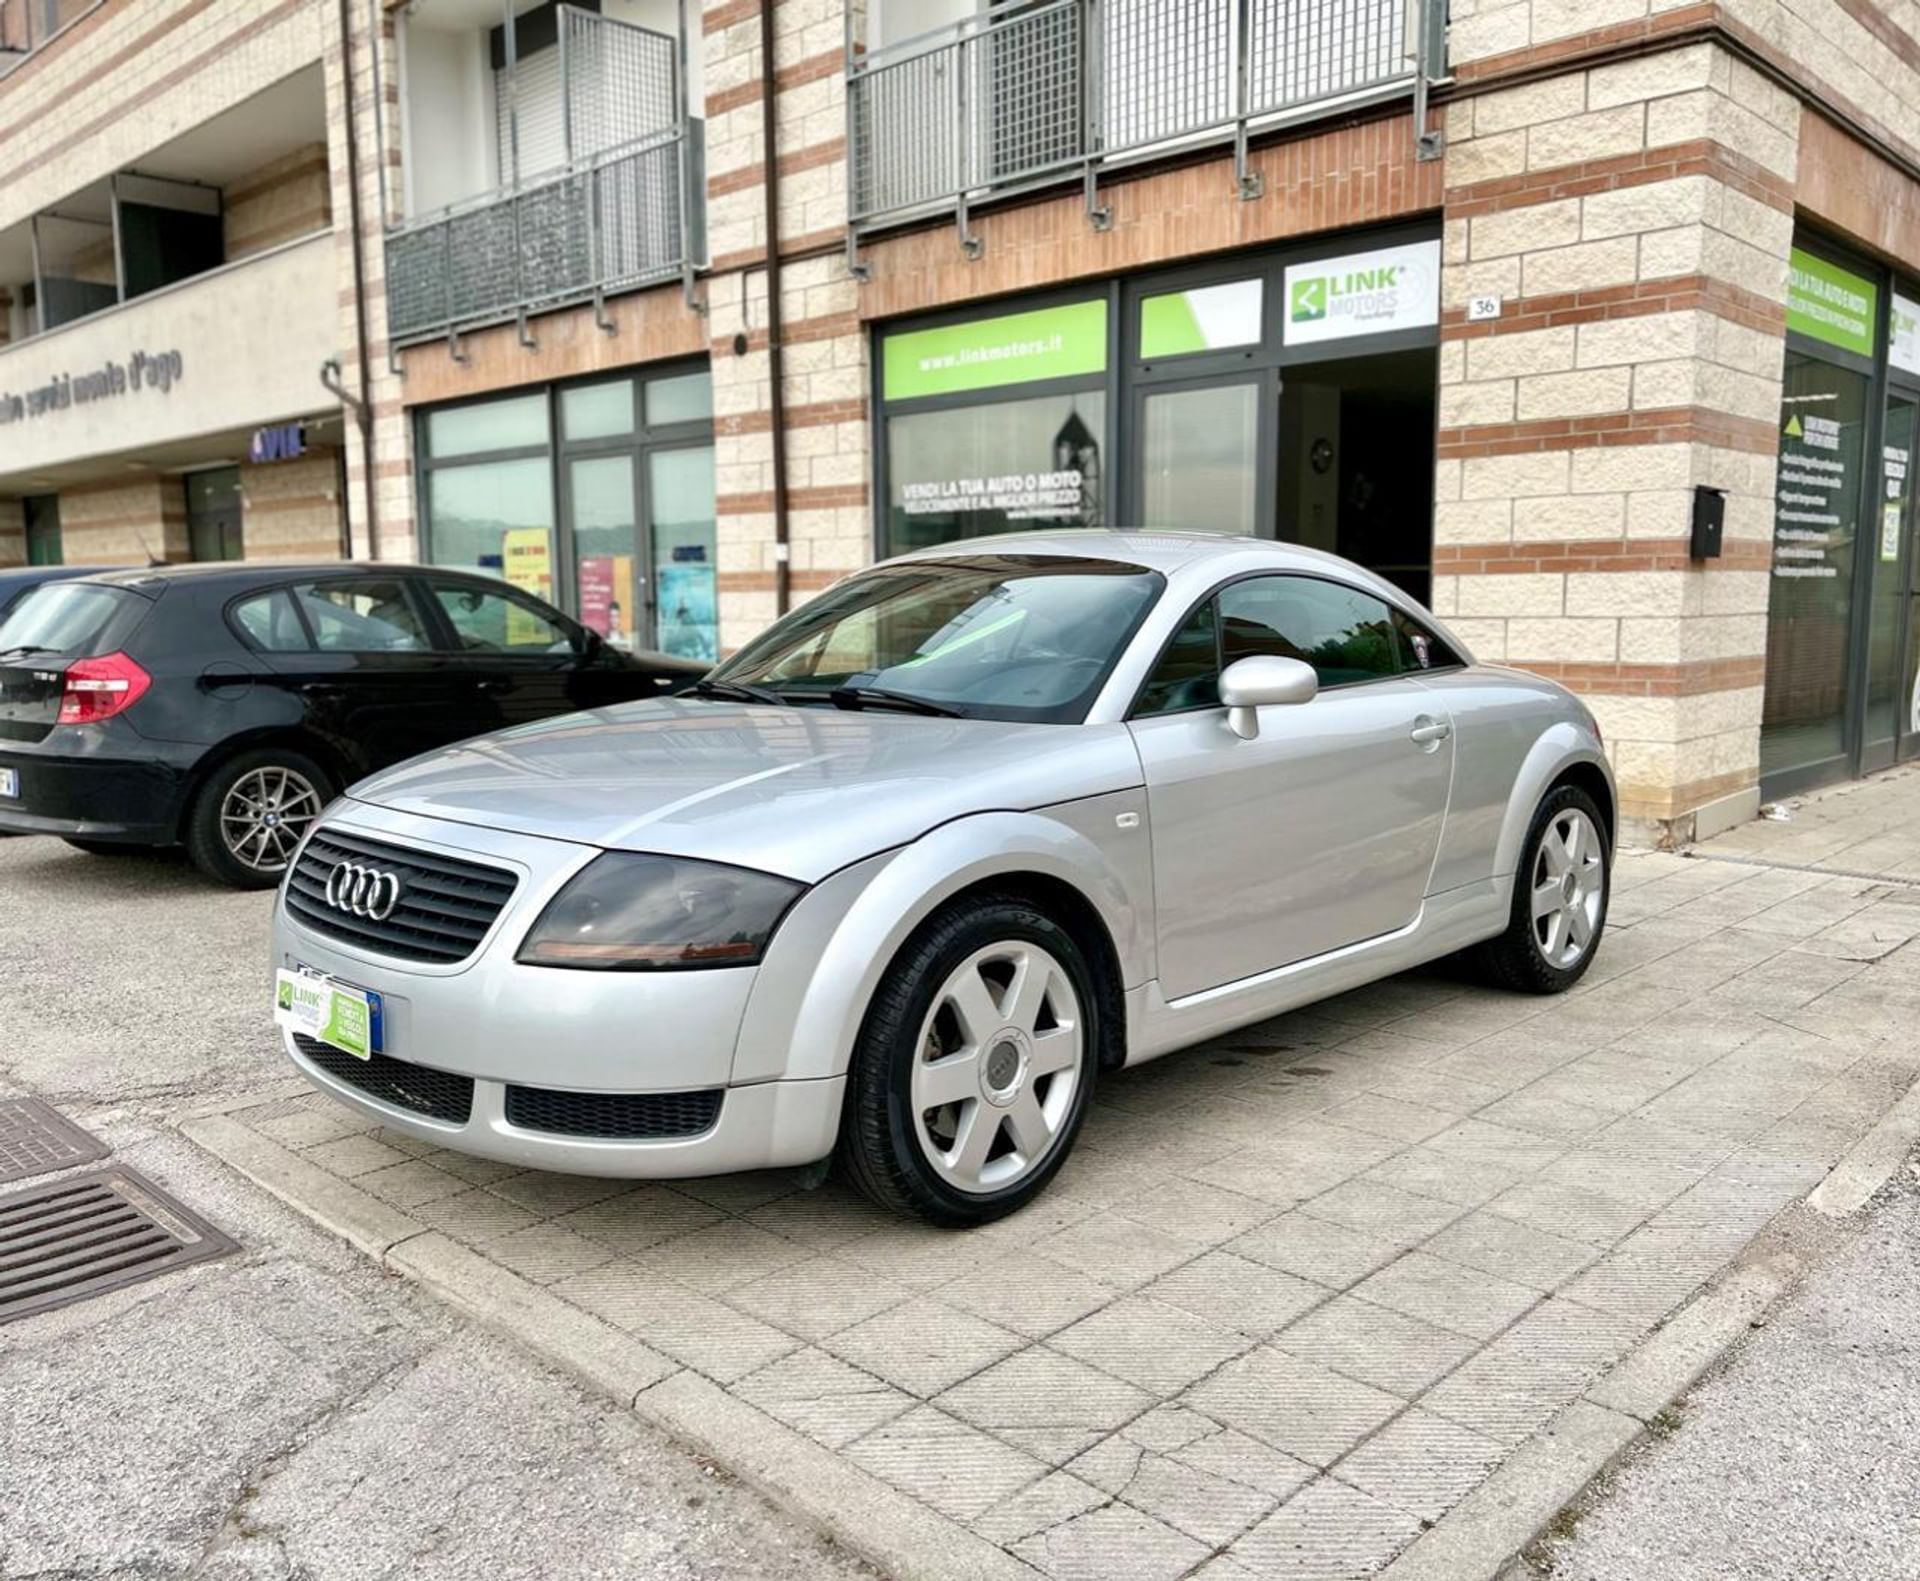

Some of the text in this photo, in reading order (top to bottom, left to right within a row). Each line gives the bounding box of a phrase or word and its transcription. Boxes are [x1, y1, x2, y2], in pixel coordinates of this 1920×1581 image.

[1330, 266, 1397, 295] LINK
[1329, 290, 1399, 316] MOTORS
[1475, 300, 1495, 315] 36
[919, 334, 1063, 372] www.linkmotors.it
[902, 471, 1081, 499] VENDI LA TUA AUTO O MOTO
[294, 986, 321, 1008] LINK
